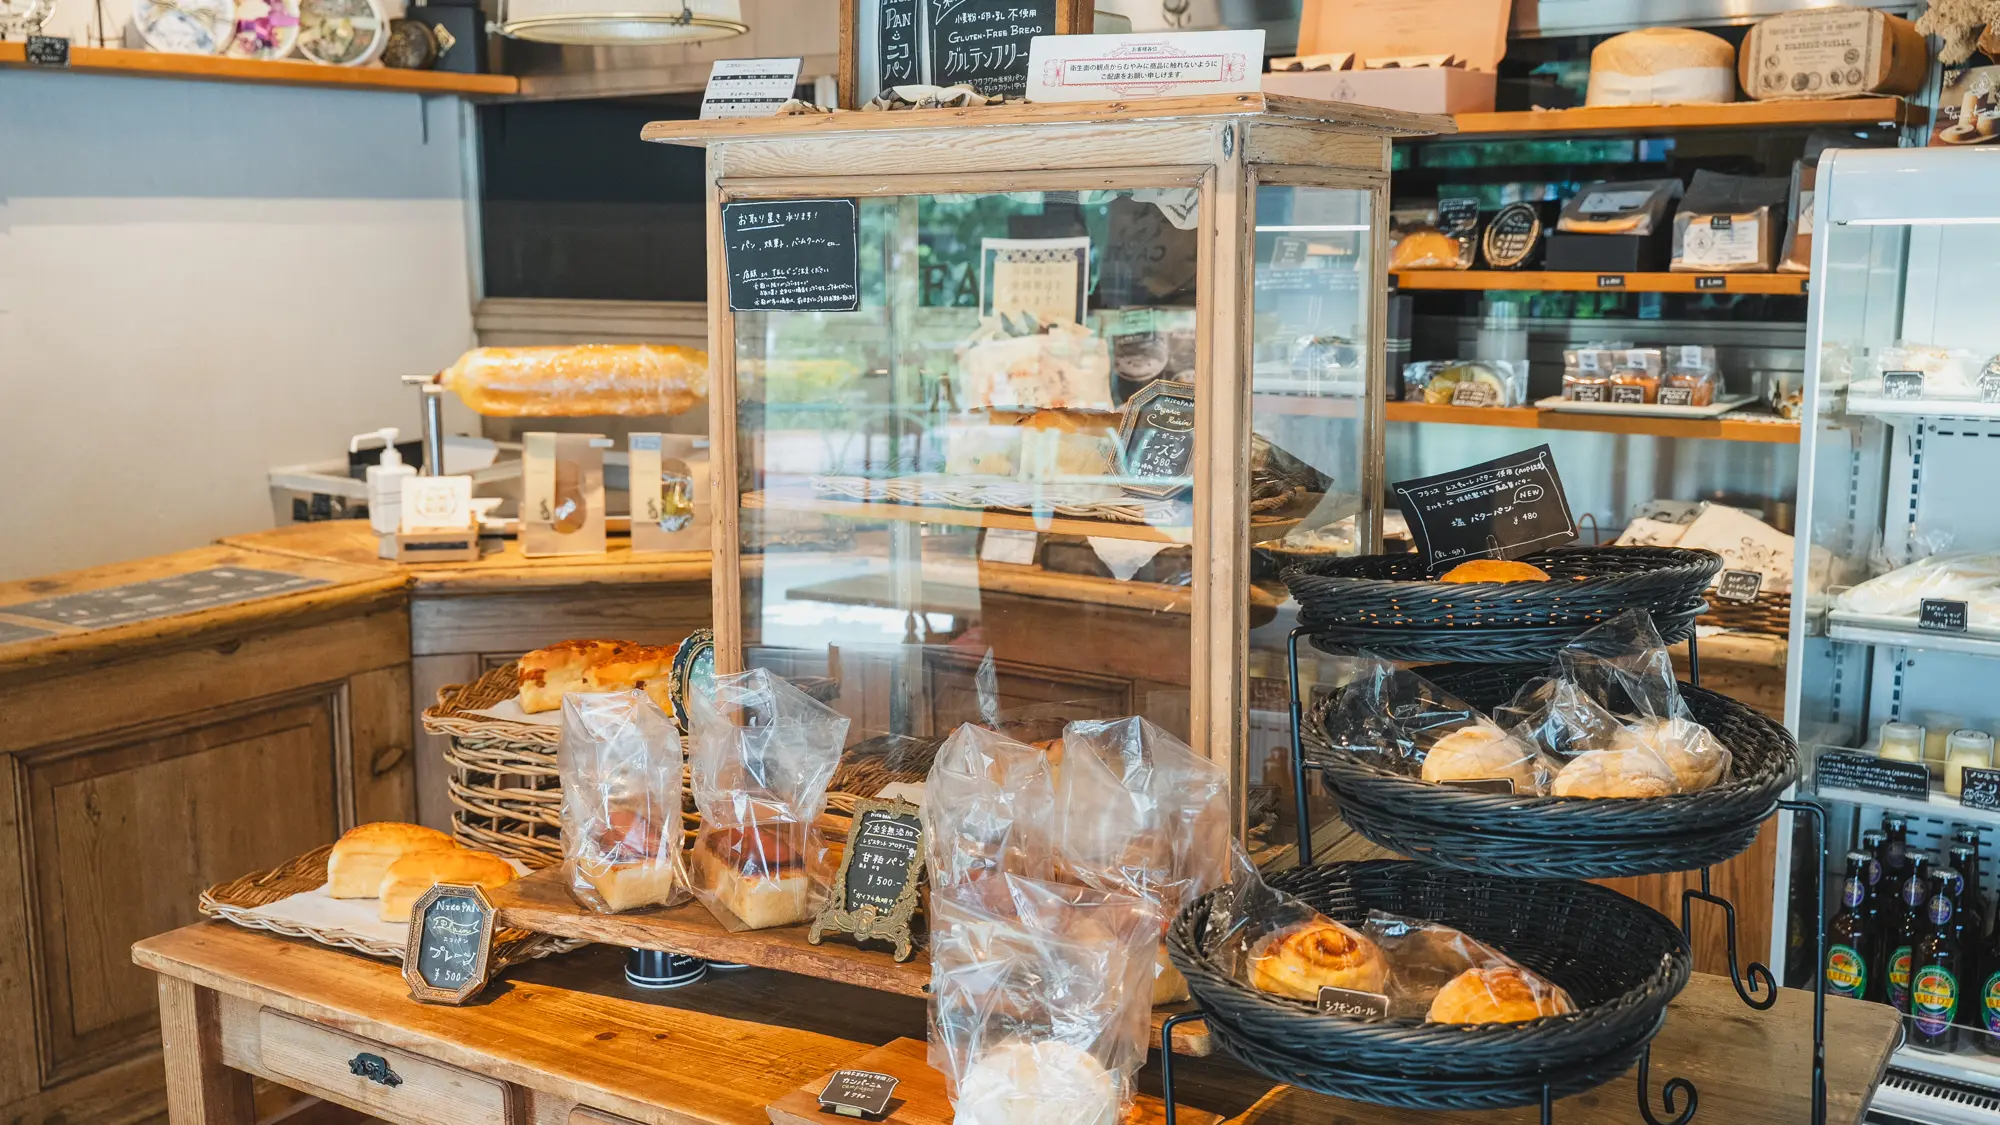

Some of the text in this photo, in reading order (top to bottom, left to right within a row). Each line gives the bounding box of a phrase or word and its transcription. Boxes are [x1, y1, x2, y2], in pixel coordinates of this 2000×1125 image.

[1010, 25, 1042, 37] BREAD
[944, 43, 1028, 76] グルテンフリー
[1070, 60, 1218, 72] 衛生面の観点からむやみに商品に触れないように
[1519, 489, 1540, 499] NEW
[1522, 511, 1538, 521] 480
[1325, 1000, 1378, 1016] シナモンロール
